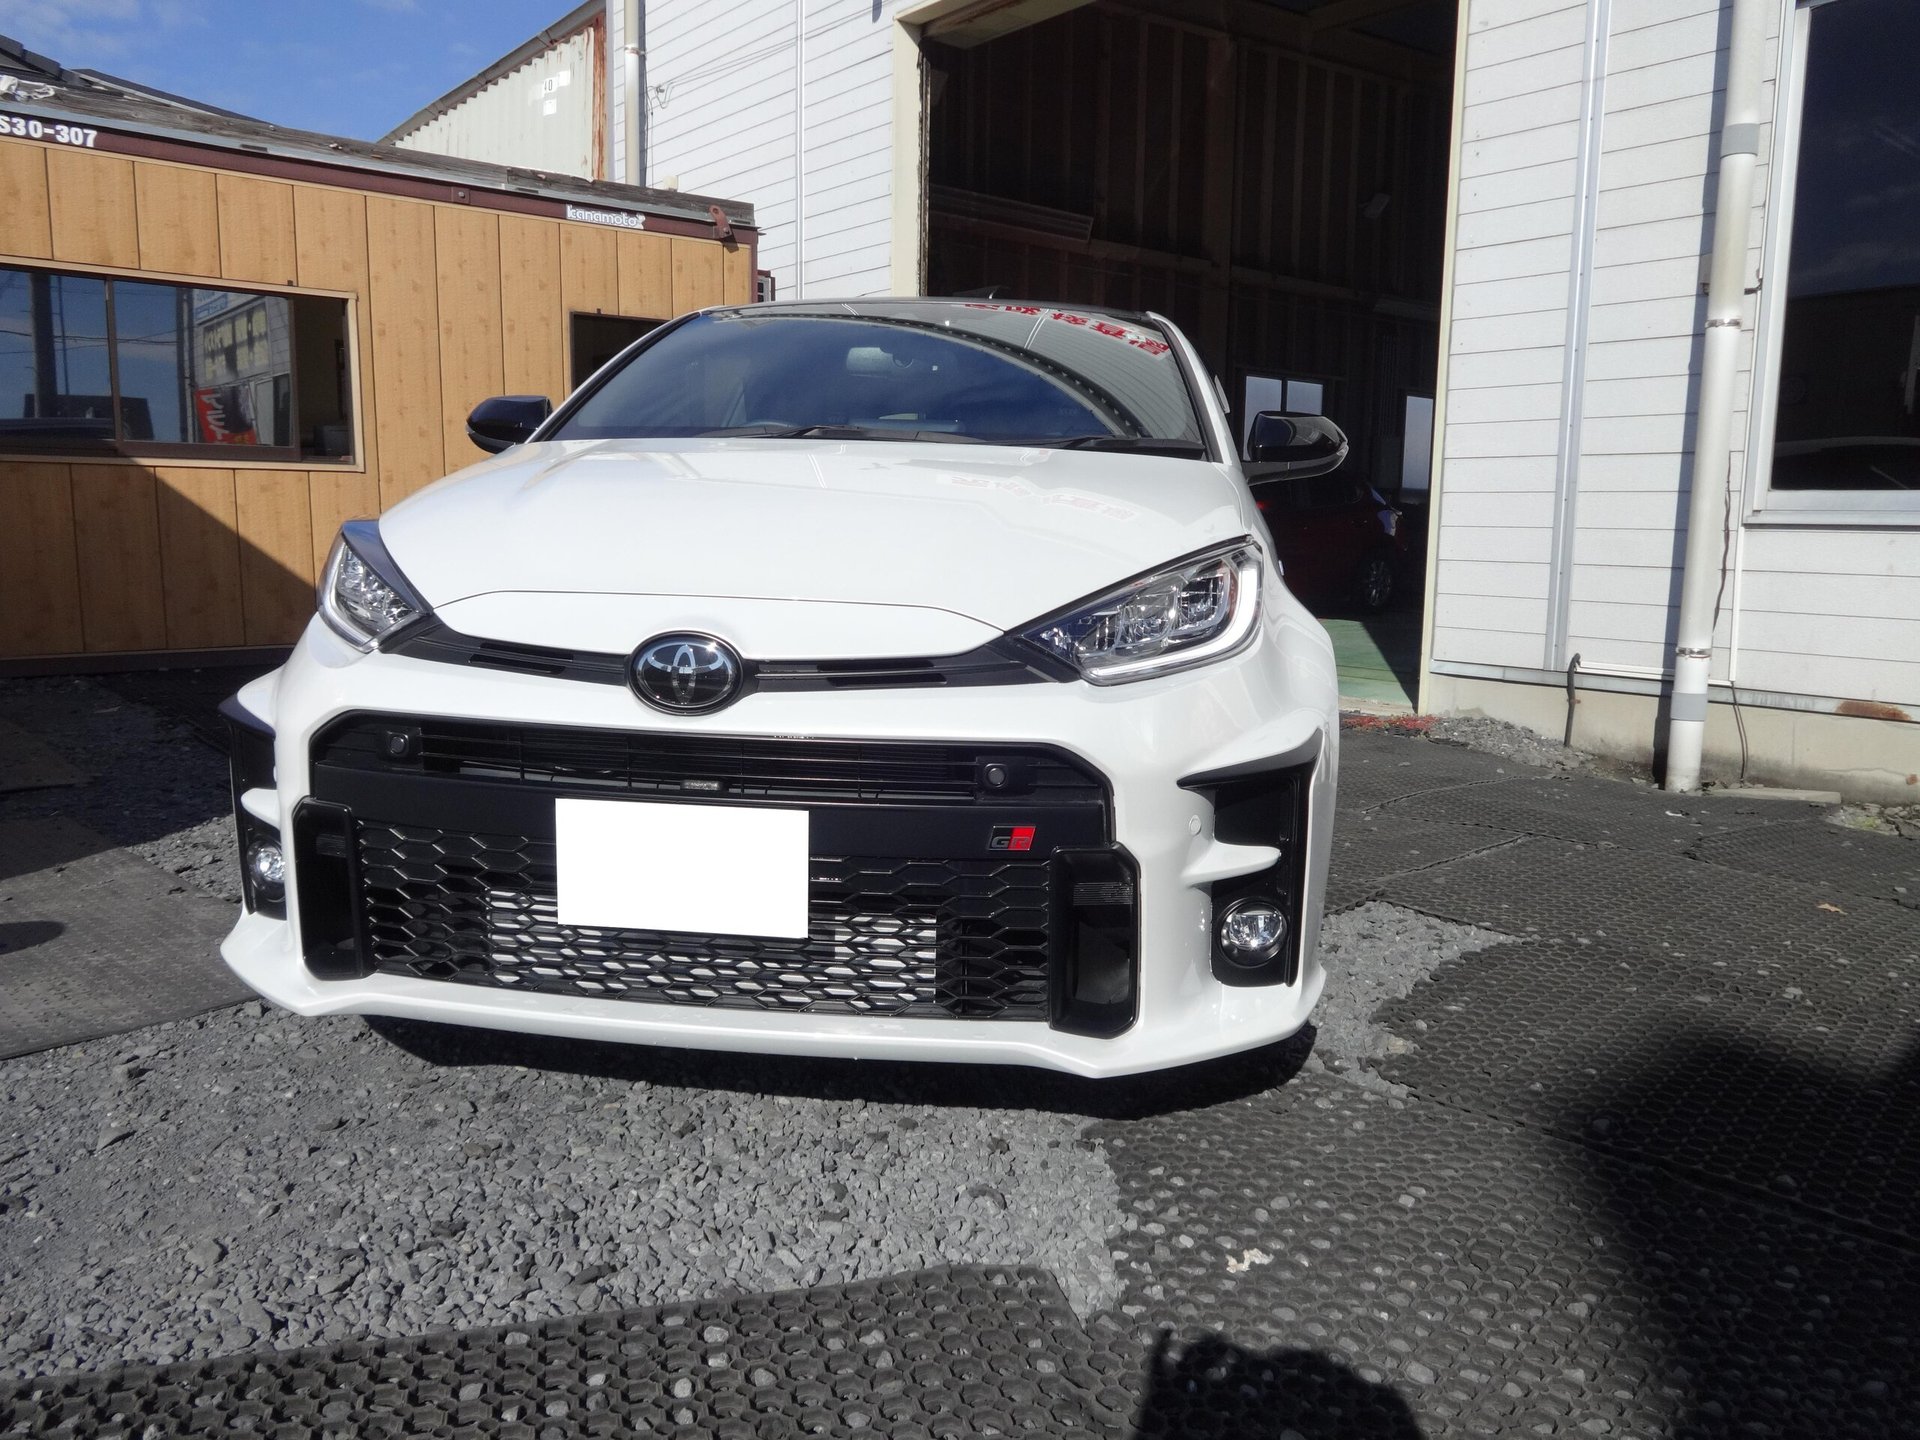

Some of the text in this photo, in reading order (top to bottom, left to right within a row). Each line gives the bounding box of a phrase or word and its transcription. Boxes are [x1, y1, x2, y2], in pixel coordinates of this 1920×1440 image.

[0, 115, 98, 148] S30-307
[566, 203, 637, 227] kanamoto
[991, 835, 1031, 848] GR
